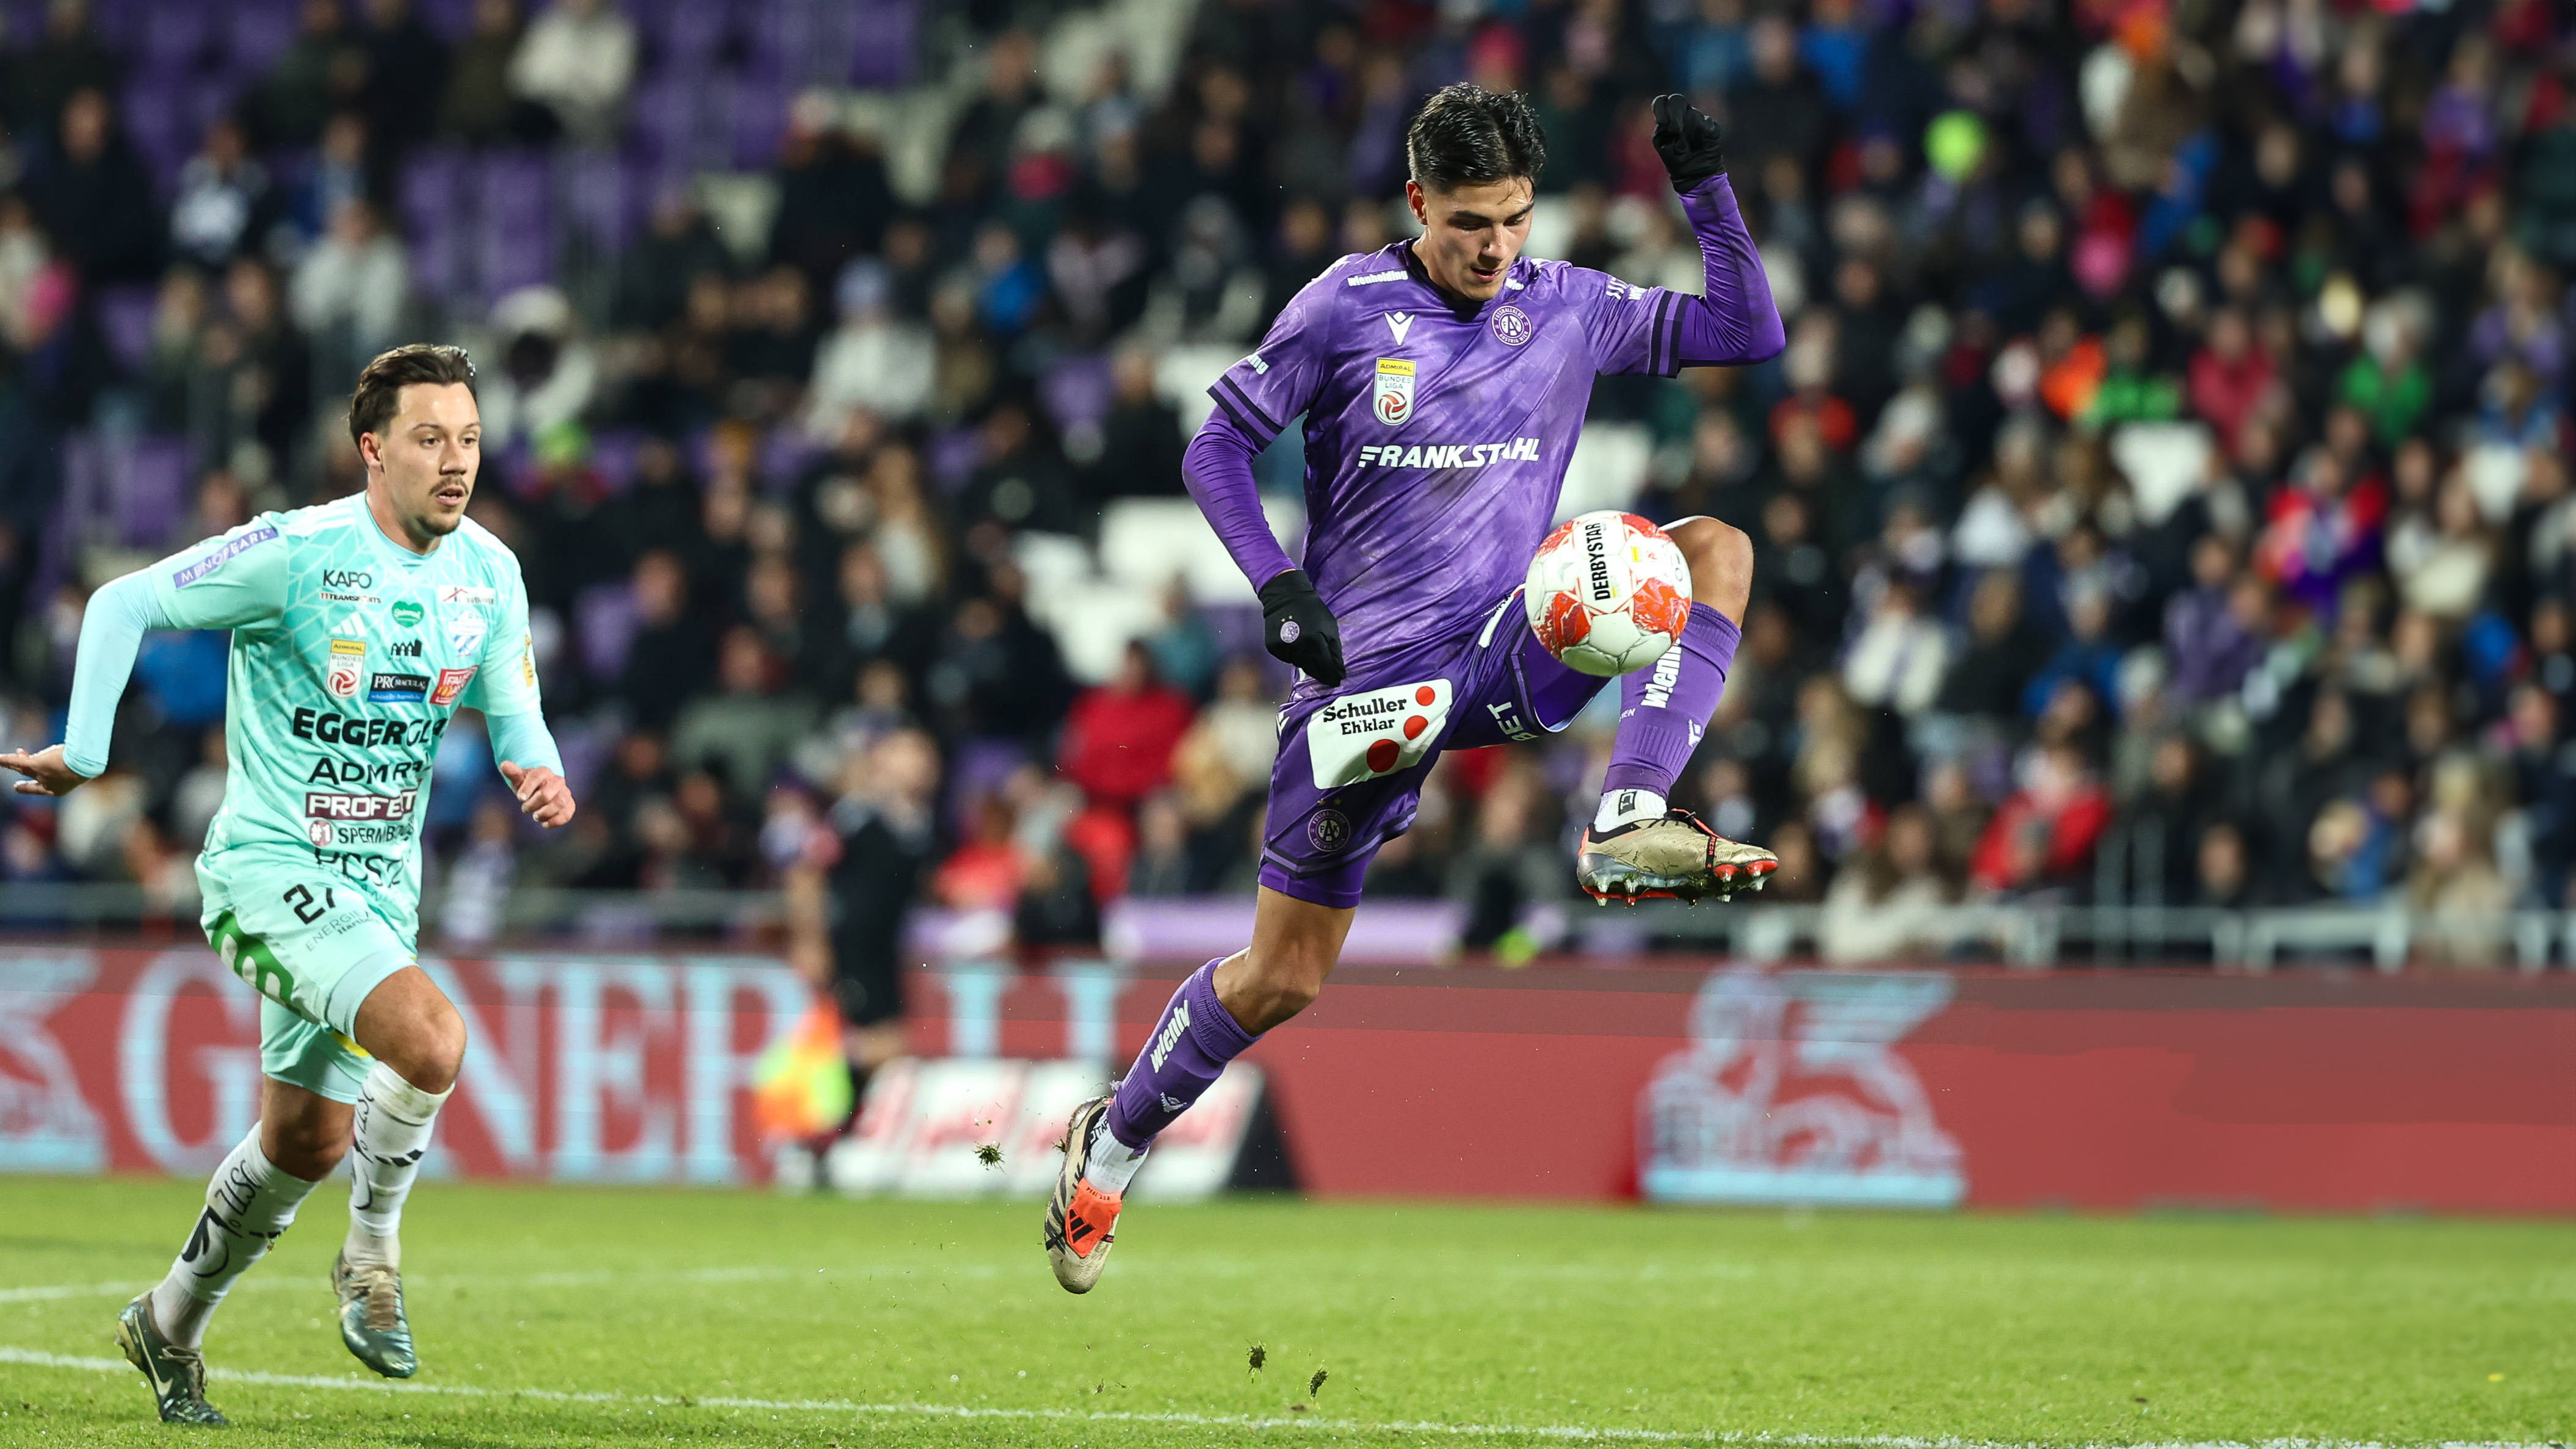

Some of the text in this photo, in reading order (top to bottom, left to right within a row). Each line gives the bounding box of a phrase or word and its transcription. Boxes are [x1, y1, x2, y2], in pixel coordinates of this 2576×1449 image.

[1380, 363, 1413, 372] ADMIRAL
[1378, 375, 1412, 384] BUNDES
[1585, 522, 1612, 601] DERBYSTAR
[323, 569, 372, 589] KAPO
[1323, 698, 1408, 723] Schuller
